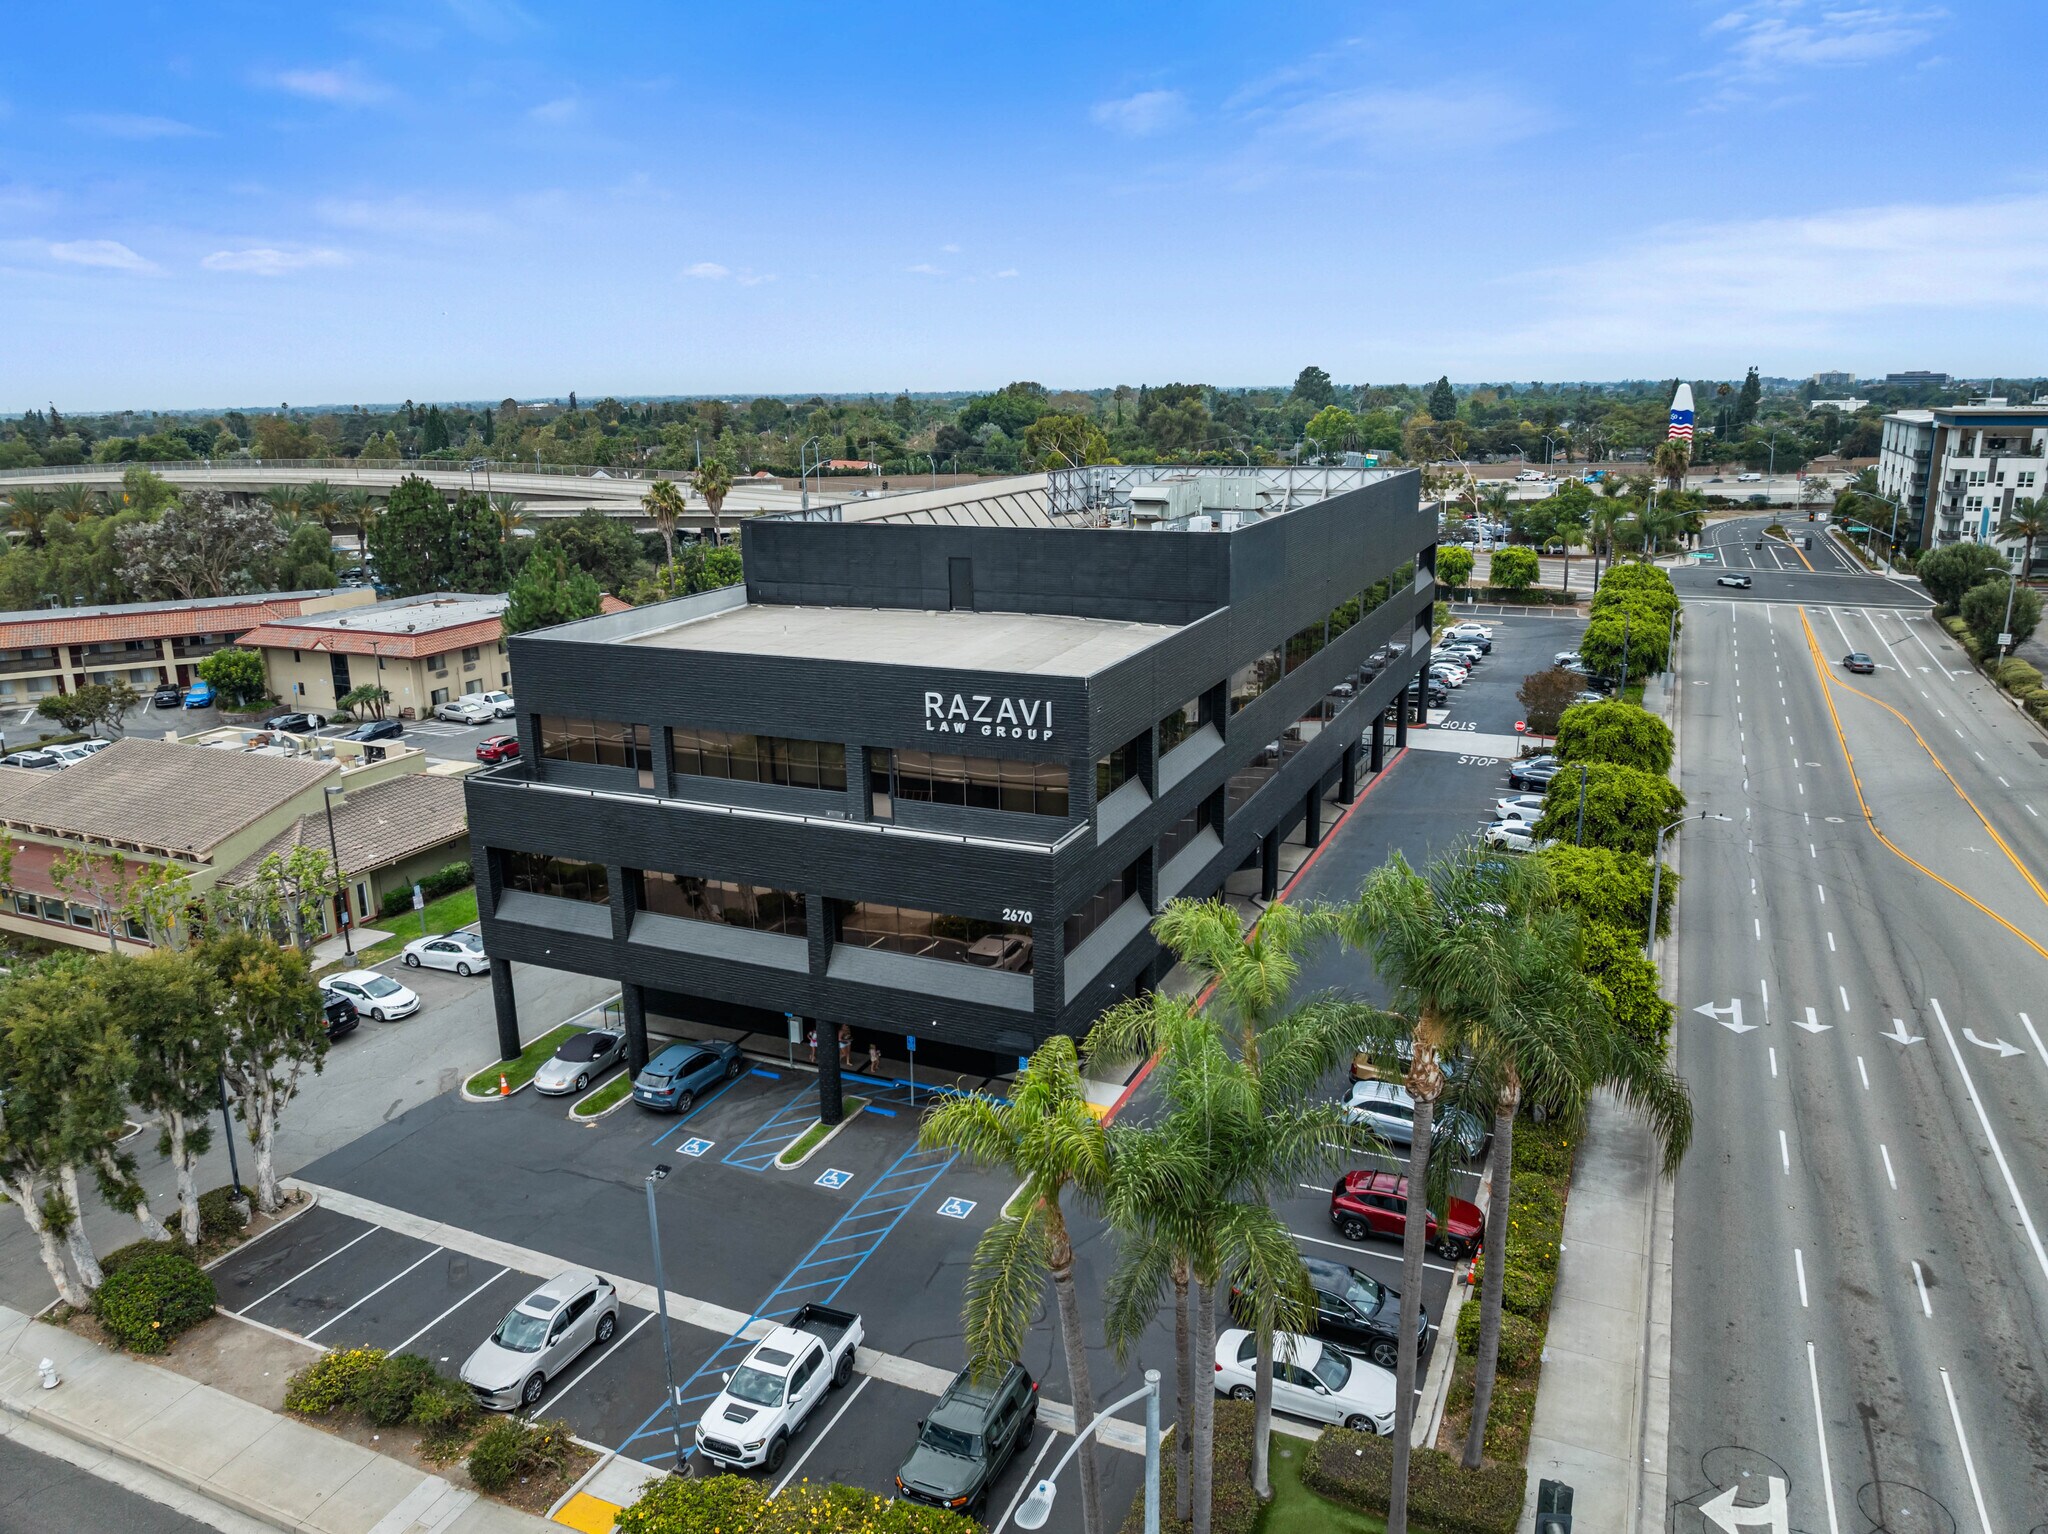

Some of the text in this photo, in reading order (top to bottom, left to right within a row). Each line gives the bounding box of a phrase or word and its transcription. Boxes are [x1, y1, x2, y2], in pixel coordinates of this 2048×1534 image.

[924, 691, 1052, 728] RAZAVI
[926, 720, 1053, 741] LAW GROUP
[1440, 720, 1477, 731] STOP
[1457, 755, 1499, 767] STOP
[1002, 908, 1033, 924] 2670
